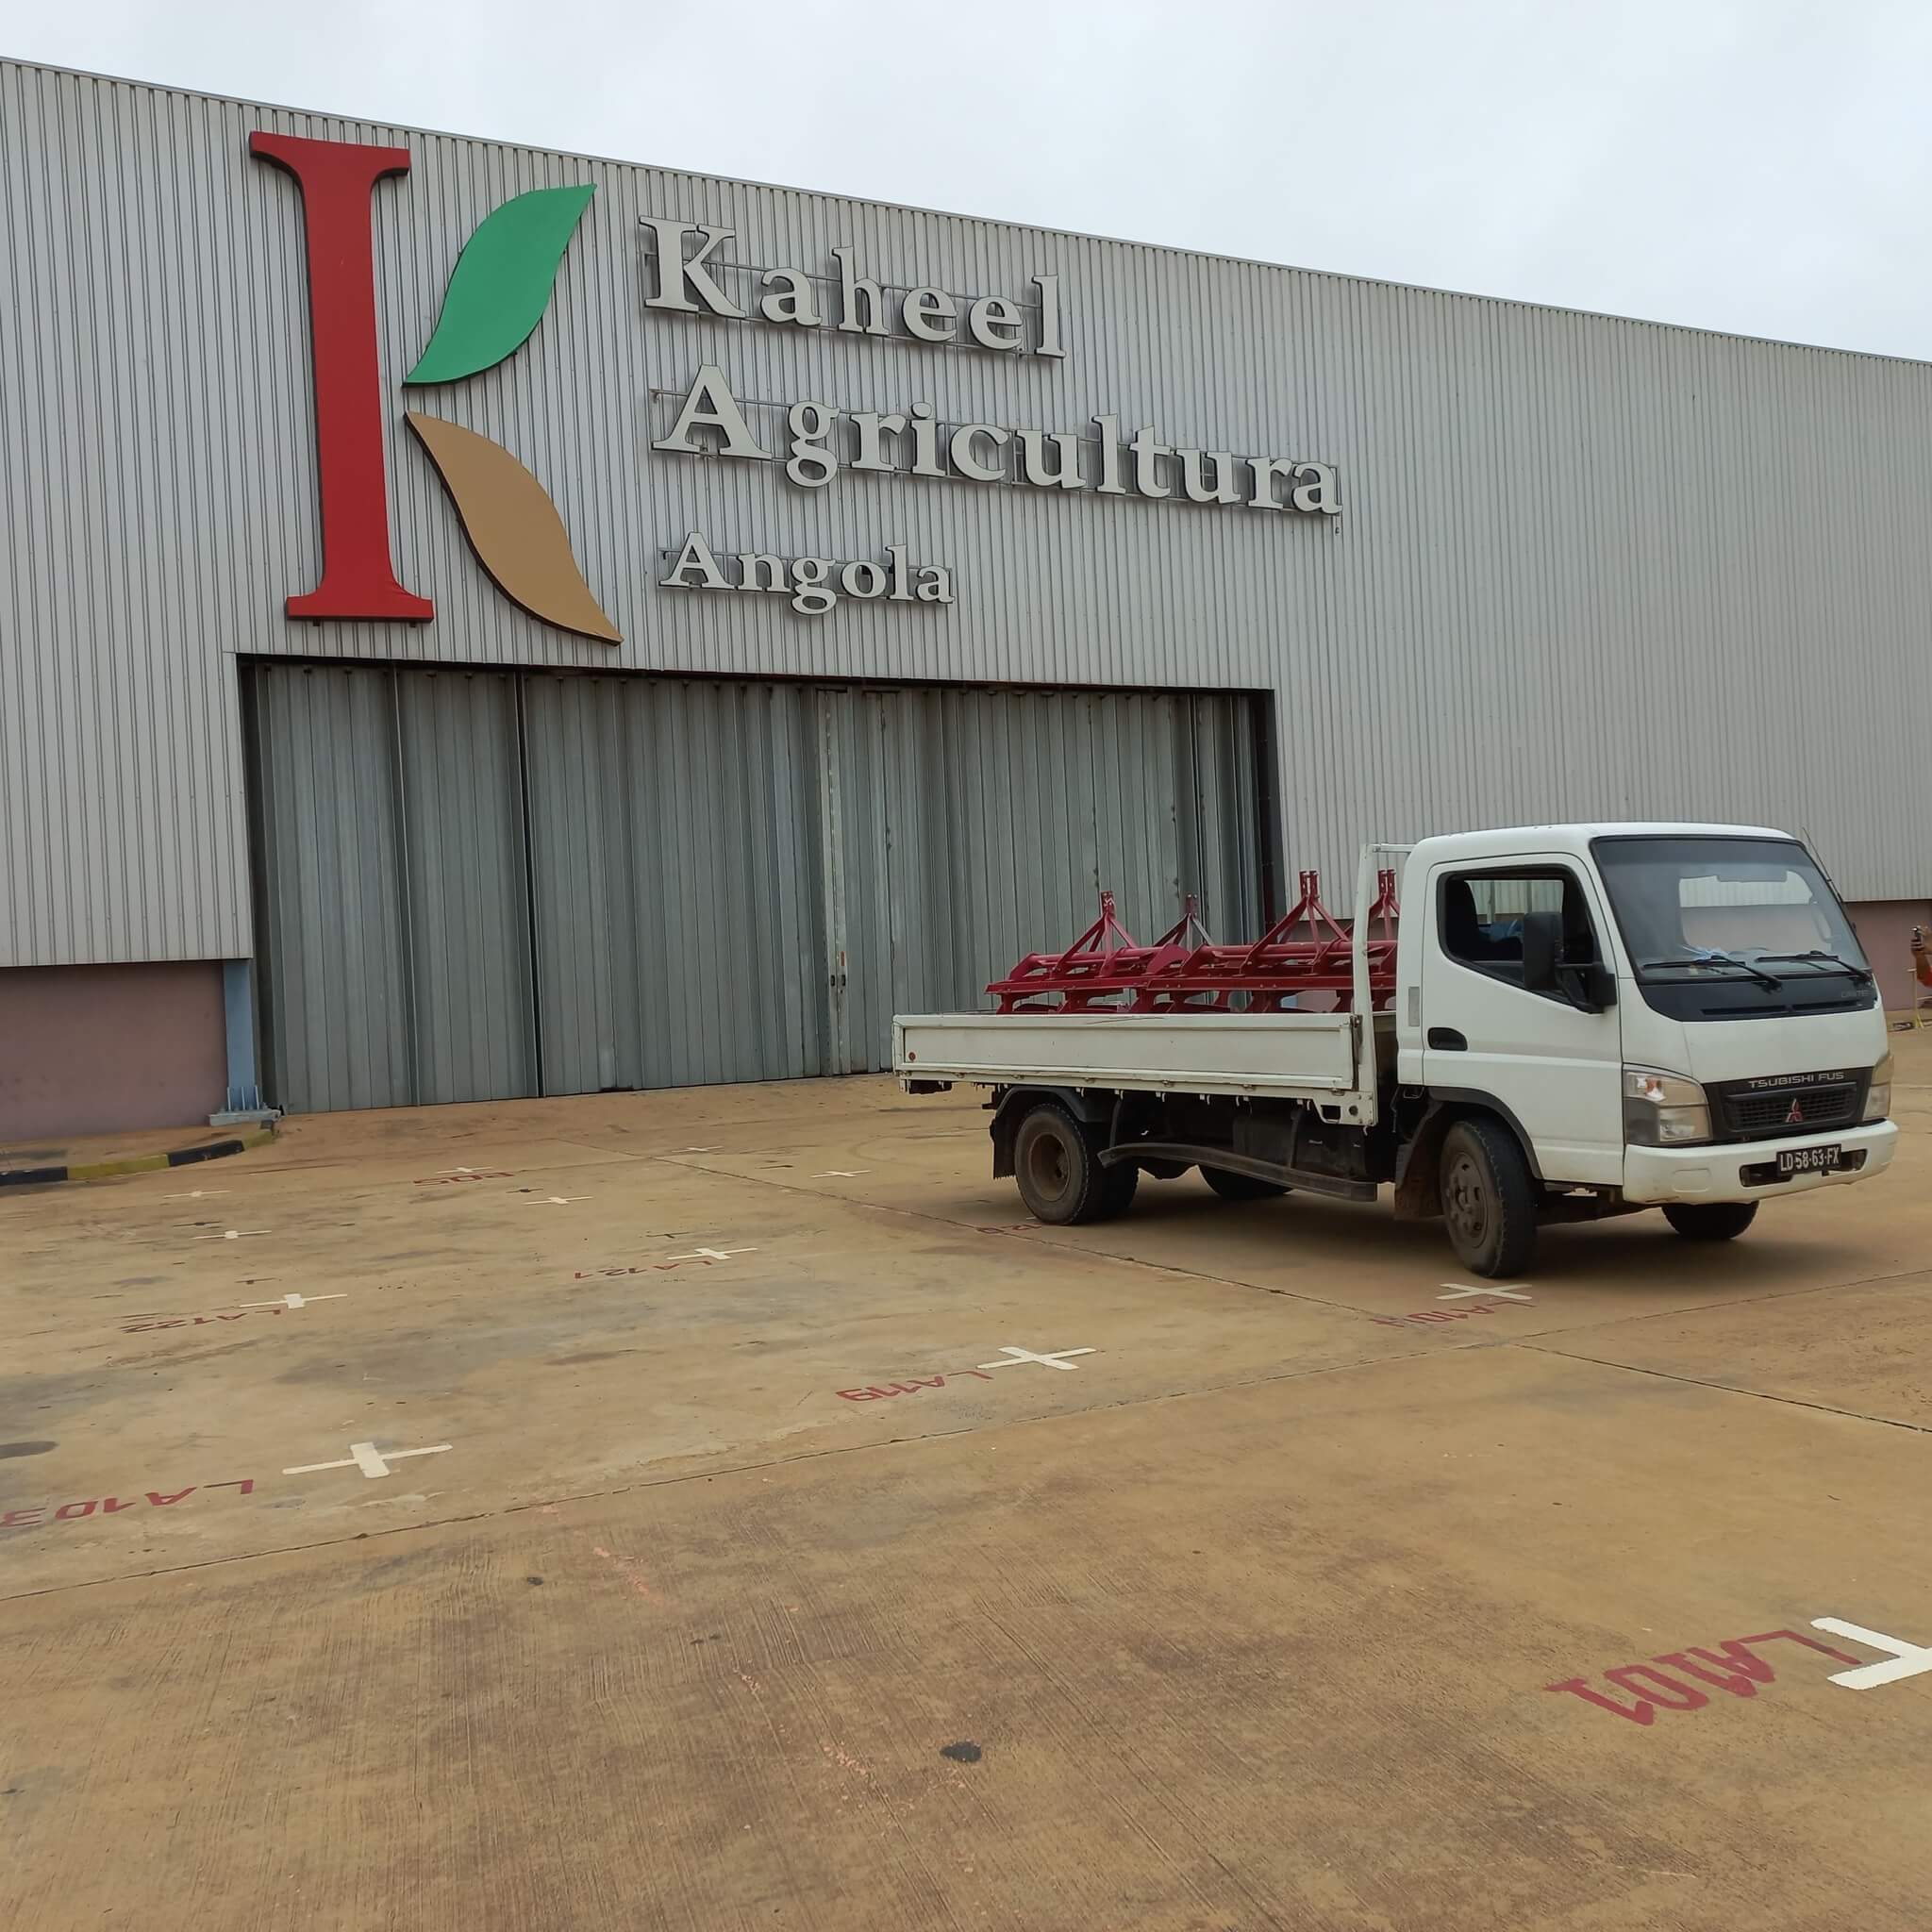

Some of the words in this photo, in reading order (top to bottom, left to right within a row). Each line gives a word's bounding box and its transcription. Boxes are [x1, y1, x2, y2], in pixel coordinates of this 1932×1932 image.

[639, 215, 1066, 359] Kaheel
[651, 364, 1343, 515] Agricultura
[658, 531, 955, 616] Angola
[836, 1370, 994, 1402] LA119
[1543, 1629, 1864, 1726] LA101
